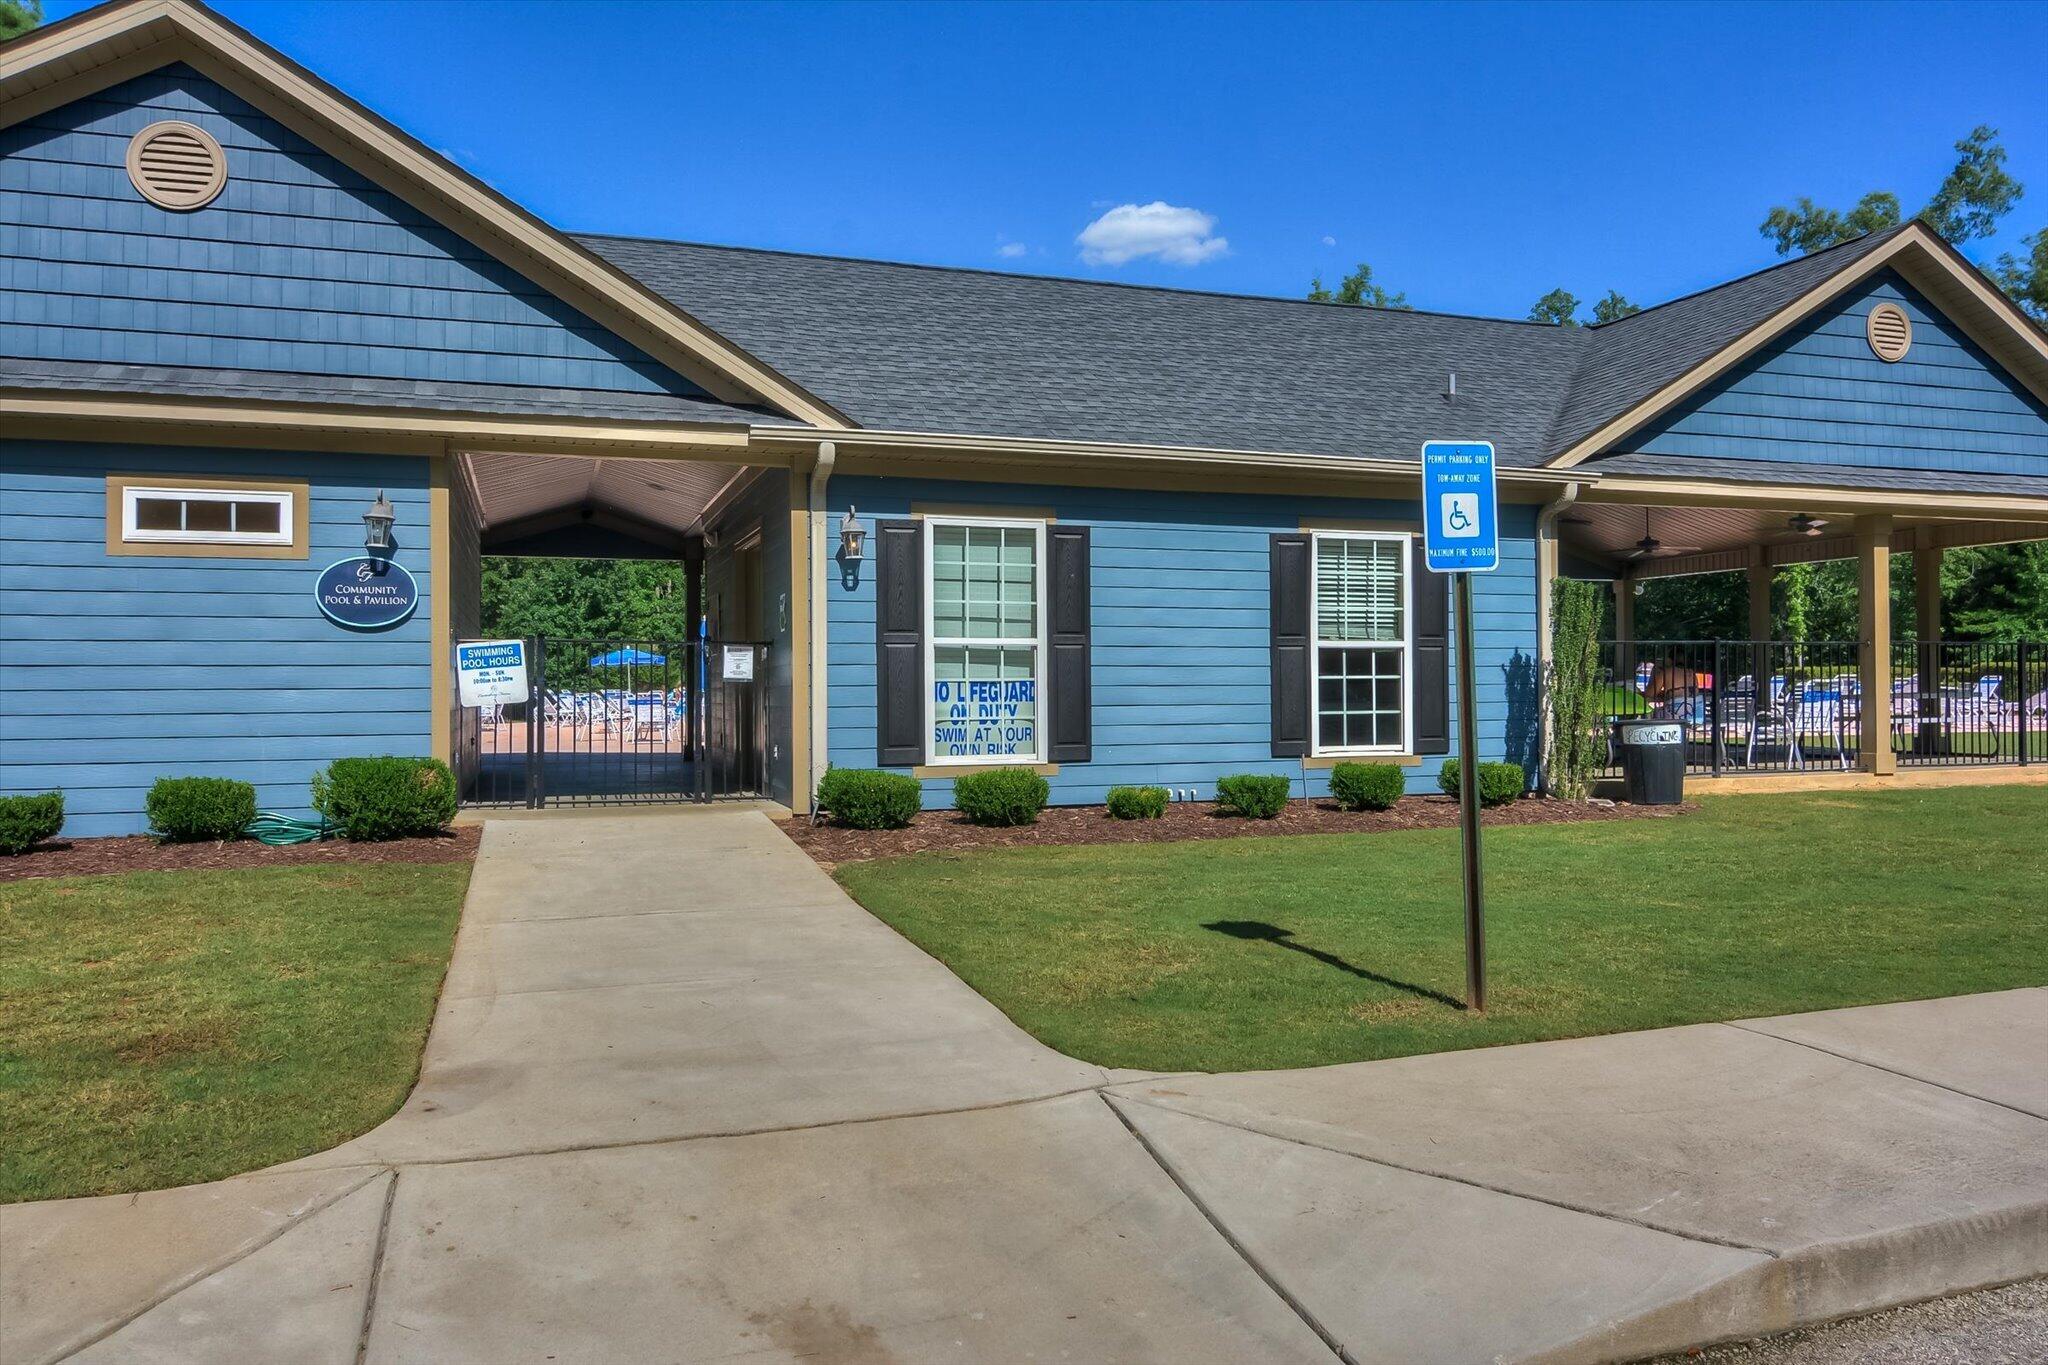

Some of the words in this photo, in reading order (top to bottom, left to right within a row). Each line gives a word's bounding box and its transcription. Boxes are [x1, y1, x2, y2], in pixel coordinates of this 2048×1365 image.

[1427, 455, 1447, 464] PERMIT
[1448, 455, 1473, 464] PARKING
[1474, 455, 1489, 464] ONLY
[1437, 474, 1466, 483] TOW-AWAY
[1466, 474, 1481, 483] ZONE
[1429, 548, 1454, 557] MAXIMUM
[1456, 548, 1468, 557] FINE
[1471, 547, 1495, 557] $500.00
[325, 595, 351, 605] POOL
[353, 595, 361, 605] &
[364, 596, 408, 605] PAVILION
[468, 647, 513, 658] SWIMMING
[462, 659, 487, 669] POOL
[489, 656, 520, 666] HOURS
[957, 681, 1035, 702] LFEGUARD
[974, 727, 991, 742] AT
